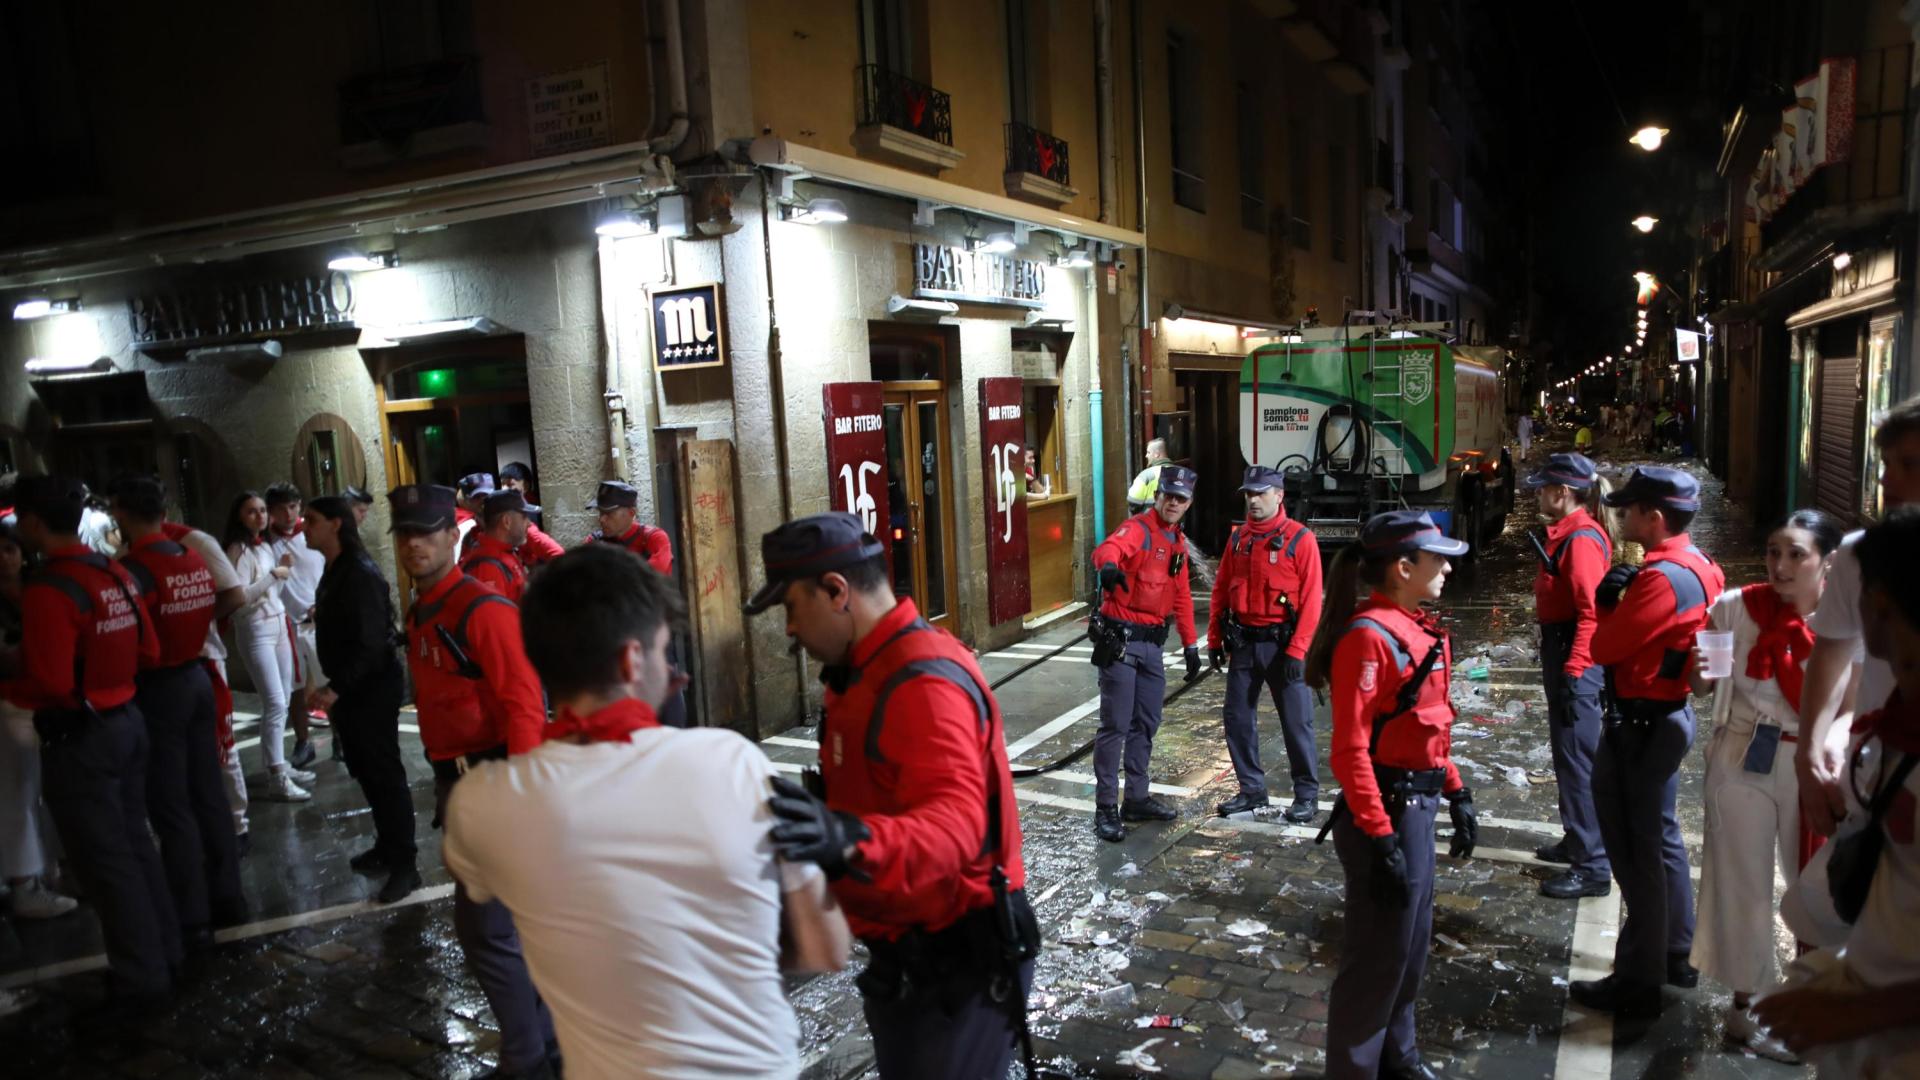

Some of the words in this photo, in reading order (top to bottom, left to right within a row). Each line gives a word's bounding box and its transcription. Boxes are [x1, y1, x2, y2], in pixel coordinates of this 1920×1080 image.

[915, 242, 965, 290] BAR
[988, 406, 1001, 421] BAR
[1001, 405, 1021, 420] FITERO
[1263, 407, 1309, 417] pamplona
[834, 416, 853, 435] BAR
[853, 414, 882, 433] FITERO
[1263, 423, 1284, 431] iruña
[165, 567, 212, 588] POLICÍA
[173, 583, 213, 601] FORAL
[108, 600, 134, 617] FORA
